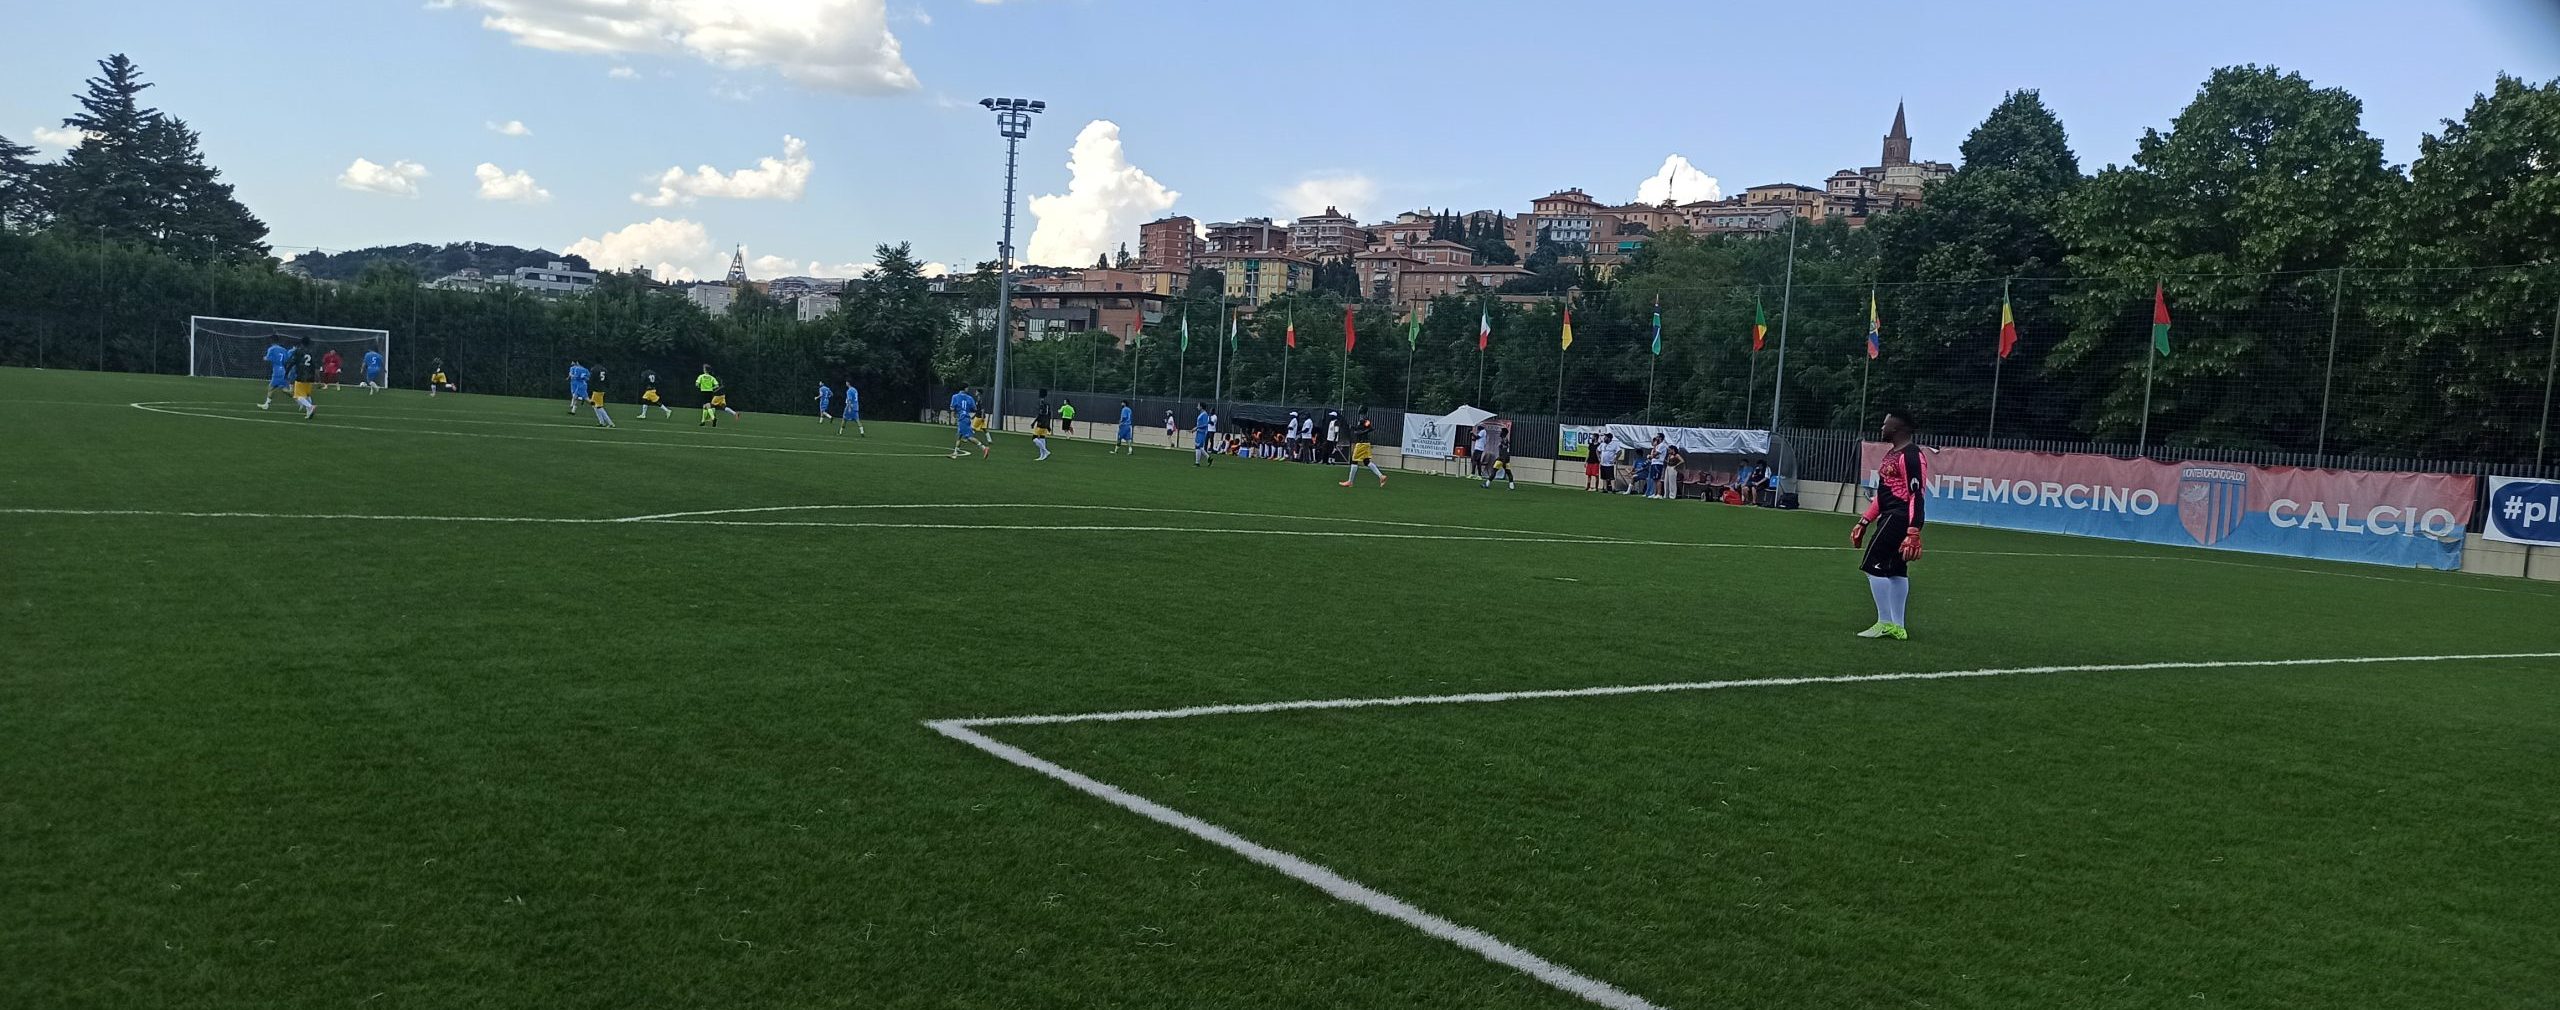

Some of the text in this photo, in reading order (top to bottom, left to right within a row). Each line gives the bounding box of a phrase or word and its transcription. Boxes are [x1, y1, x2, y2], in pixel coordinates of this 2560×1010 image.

[304, 354, 311, 366] 2
[371, 356, 377, 365] 5
[600, 371, 605, 381] 5
[961, 400, 967, 410] 11
[1868, 469, 2456, 540] NTEMORCINO CALCIO
[2503, 495, 2560, 528] #pl
